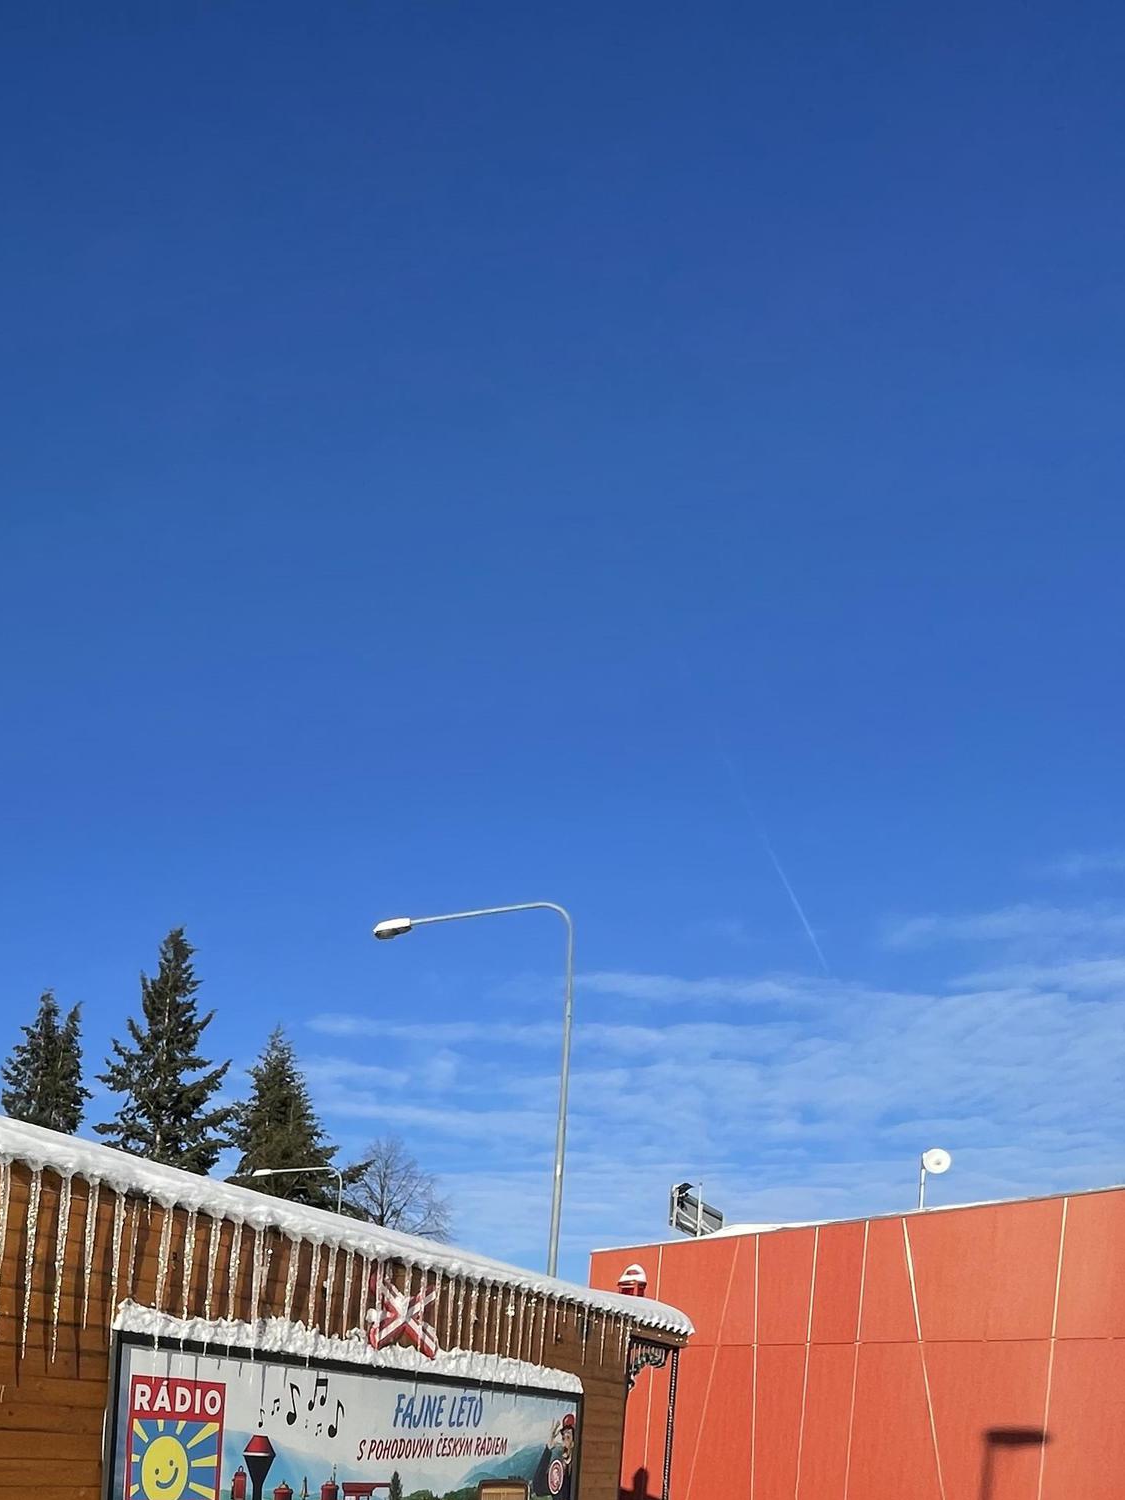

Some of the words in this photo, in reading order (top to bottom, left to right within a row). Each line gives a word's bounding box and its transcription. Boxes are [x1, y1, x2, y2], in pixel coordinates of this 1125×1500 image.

[134, 1381, 222, 1416] RÁDIO
[356, 1439, 367, 1461] S
[367, 1433, 434, 1460] POHODOVÝM
[436, 1432, 473, 1457] ČESKÝM
[474, 1432, 508, 1457] RÁDIEM
